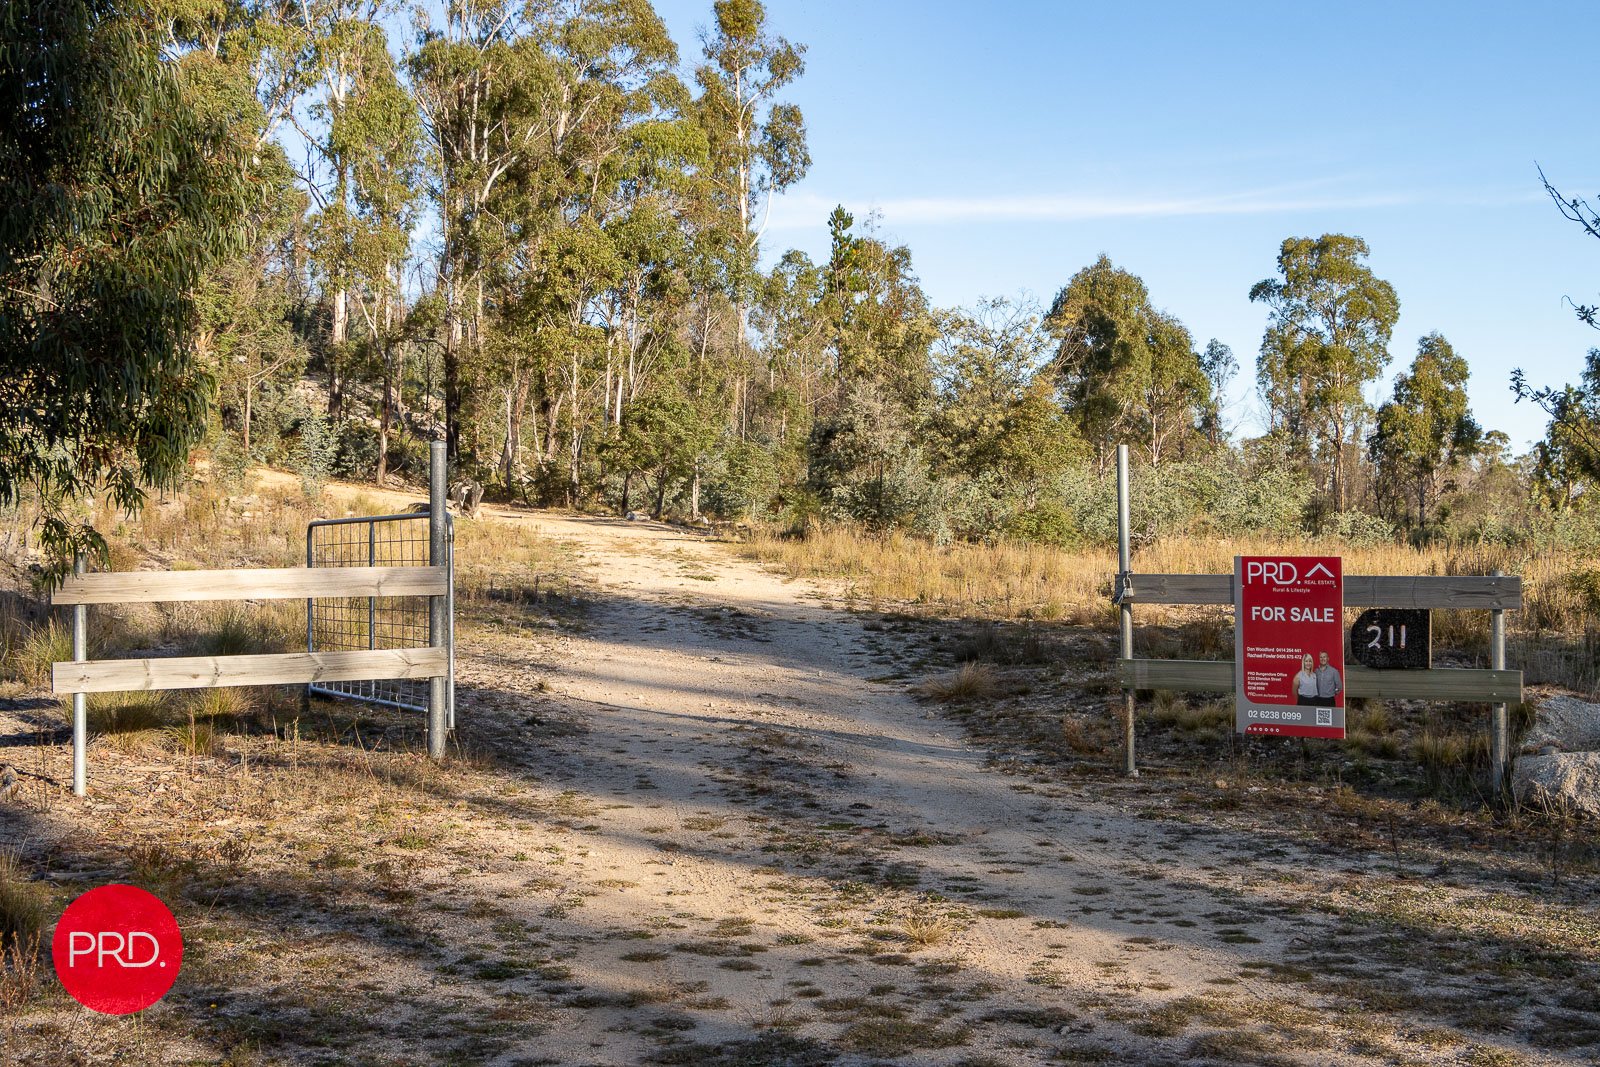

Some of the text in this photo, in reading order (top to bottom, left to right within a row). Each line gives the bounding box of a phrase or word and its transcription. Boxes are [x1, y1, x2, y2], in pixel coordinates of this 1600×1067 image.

[1247, 561, 1301, 585] PRD.
[1251, 606, 1335, 623] FOR SALE
[1366, 624, 1406, 649] 211
[1248, 710, 1302, 720] 02 6238 0999
